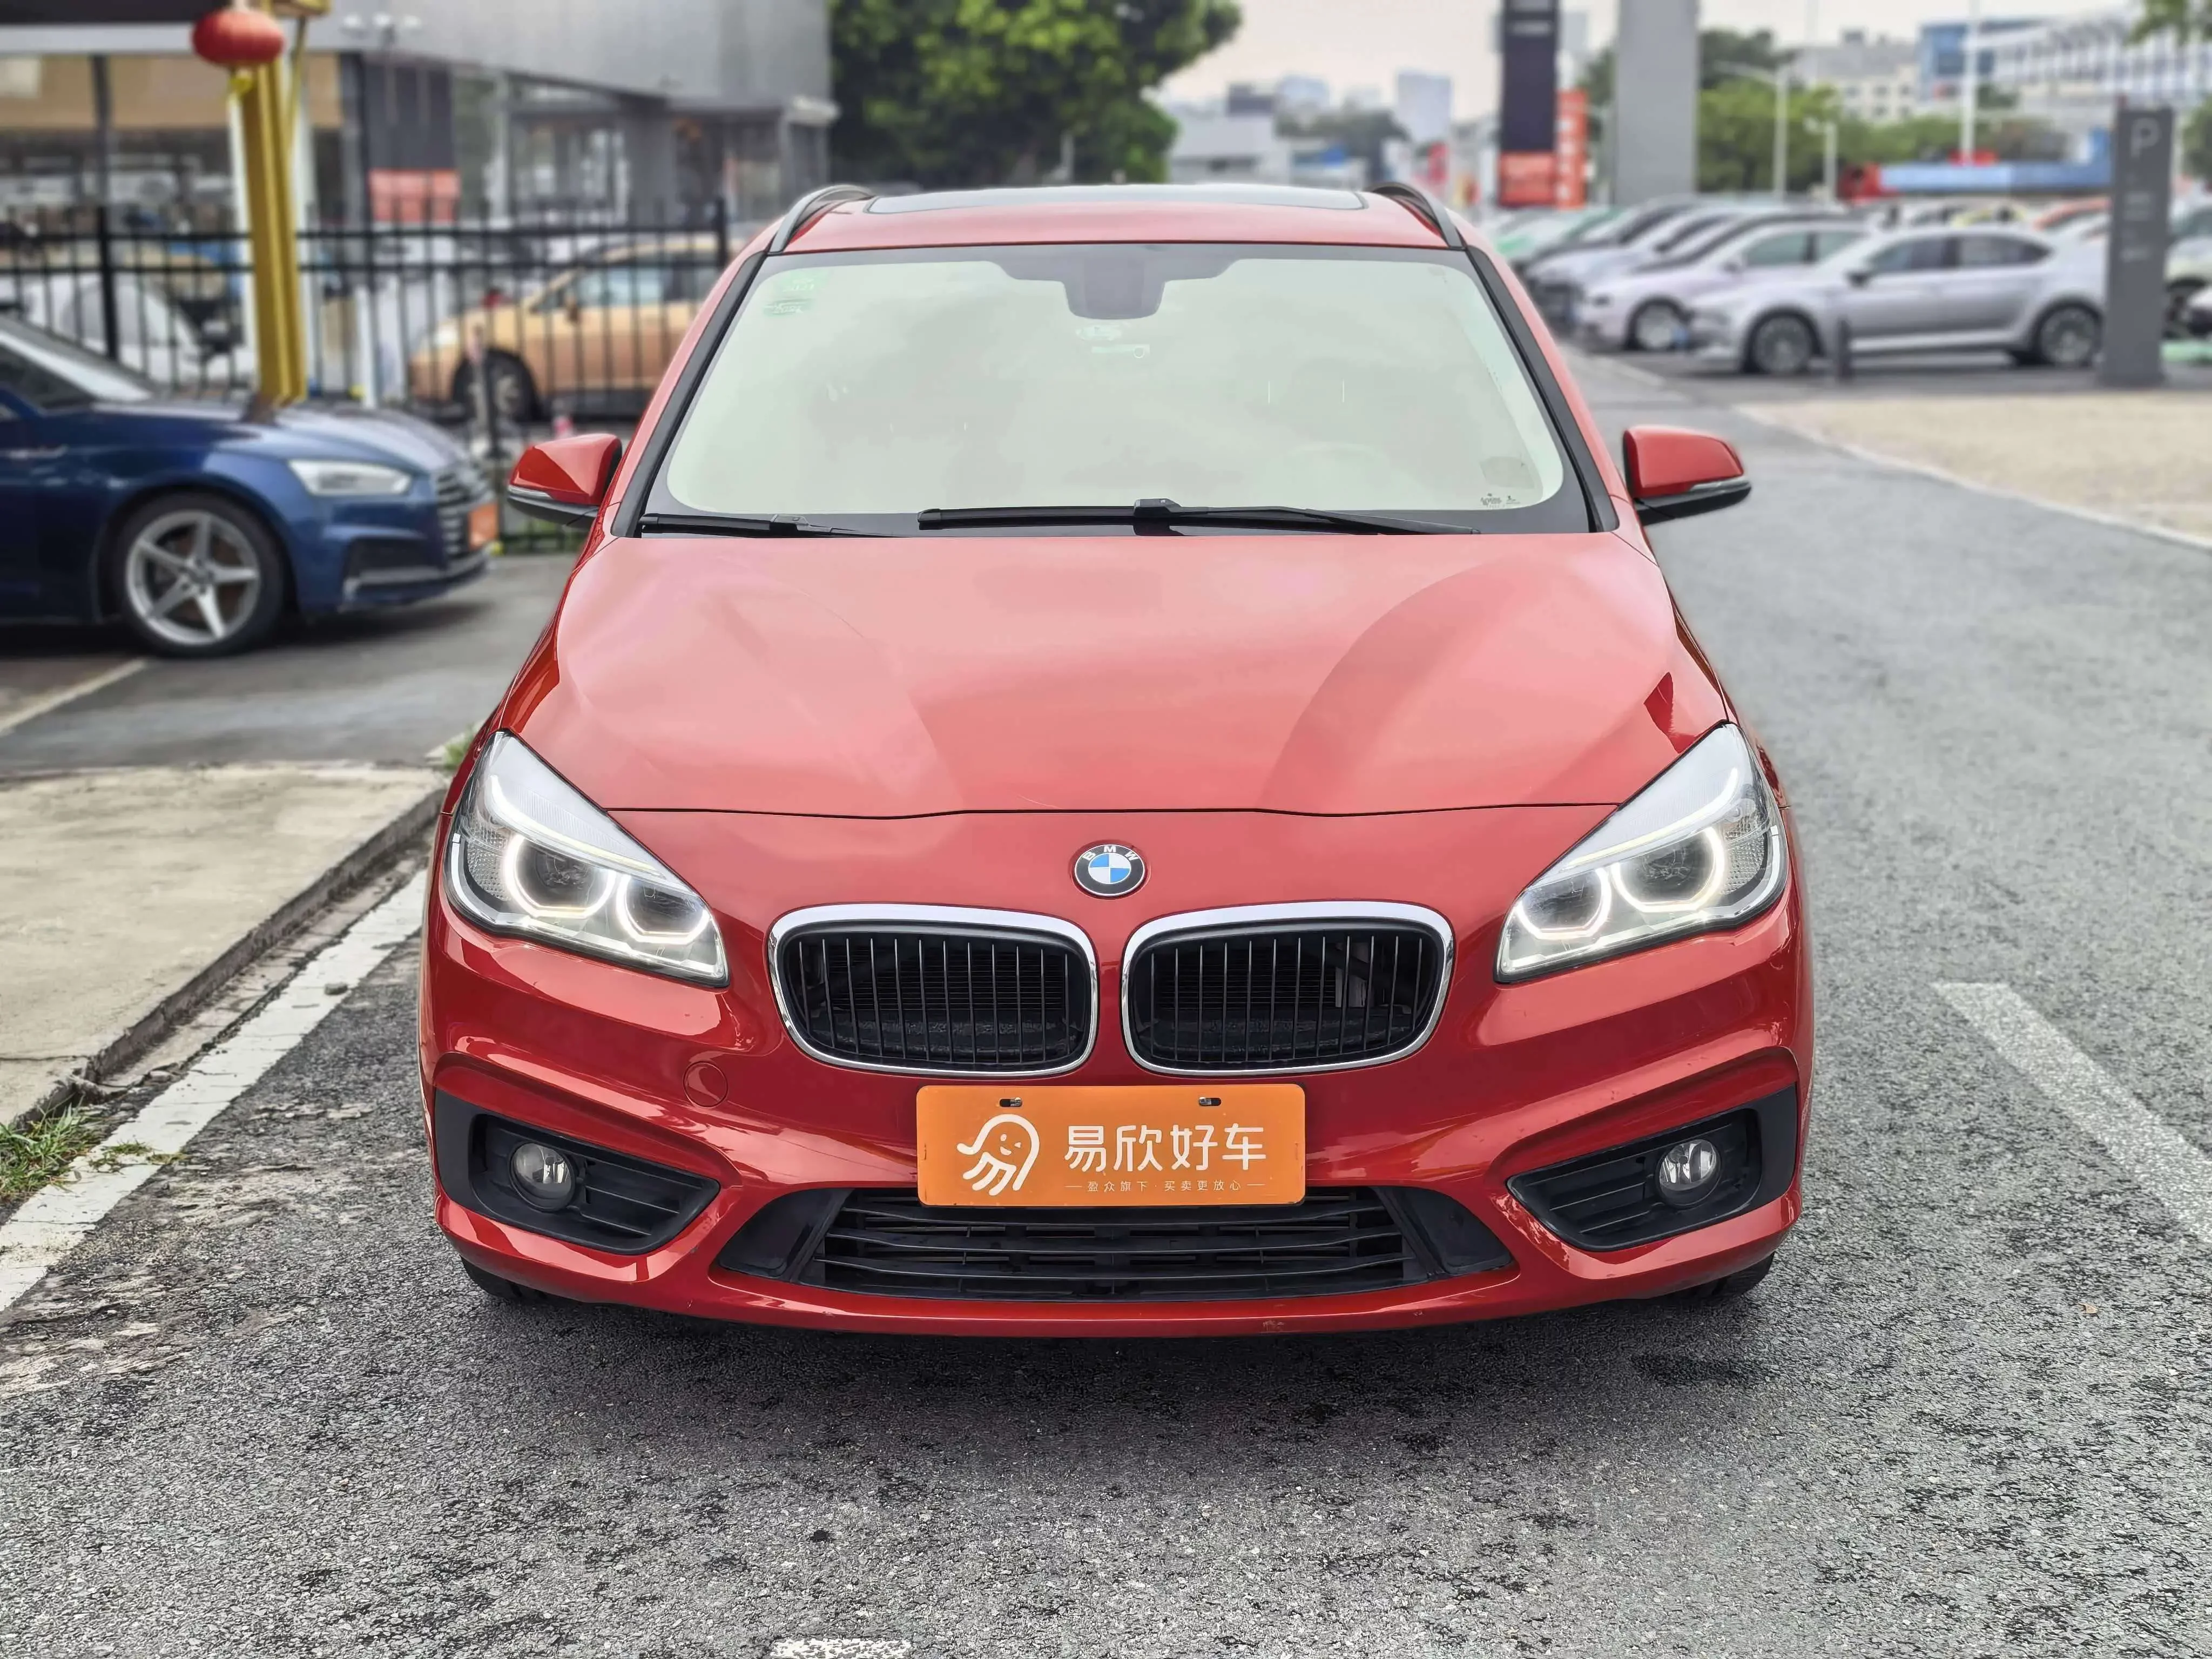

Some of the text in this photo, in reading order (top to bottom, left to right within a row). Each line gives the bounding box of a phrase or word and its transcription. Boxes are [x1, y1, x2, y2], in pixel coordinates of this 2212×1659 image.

[2130, 117, 2161, 158] P
[1082, 845, 1139, 861] BMW
[1064, 1123, 1266, 1172] 易欣好车
